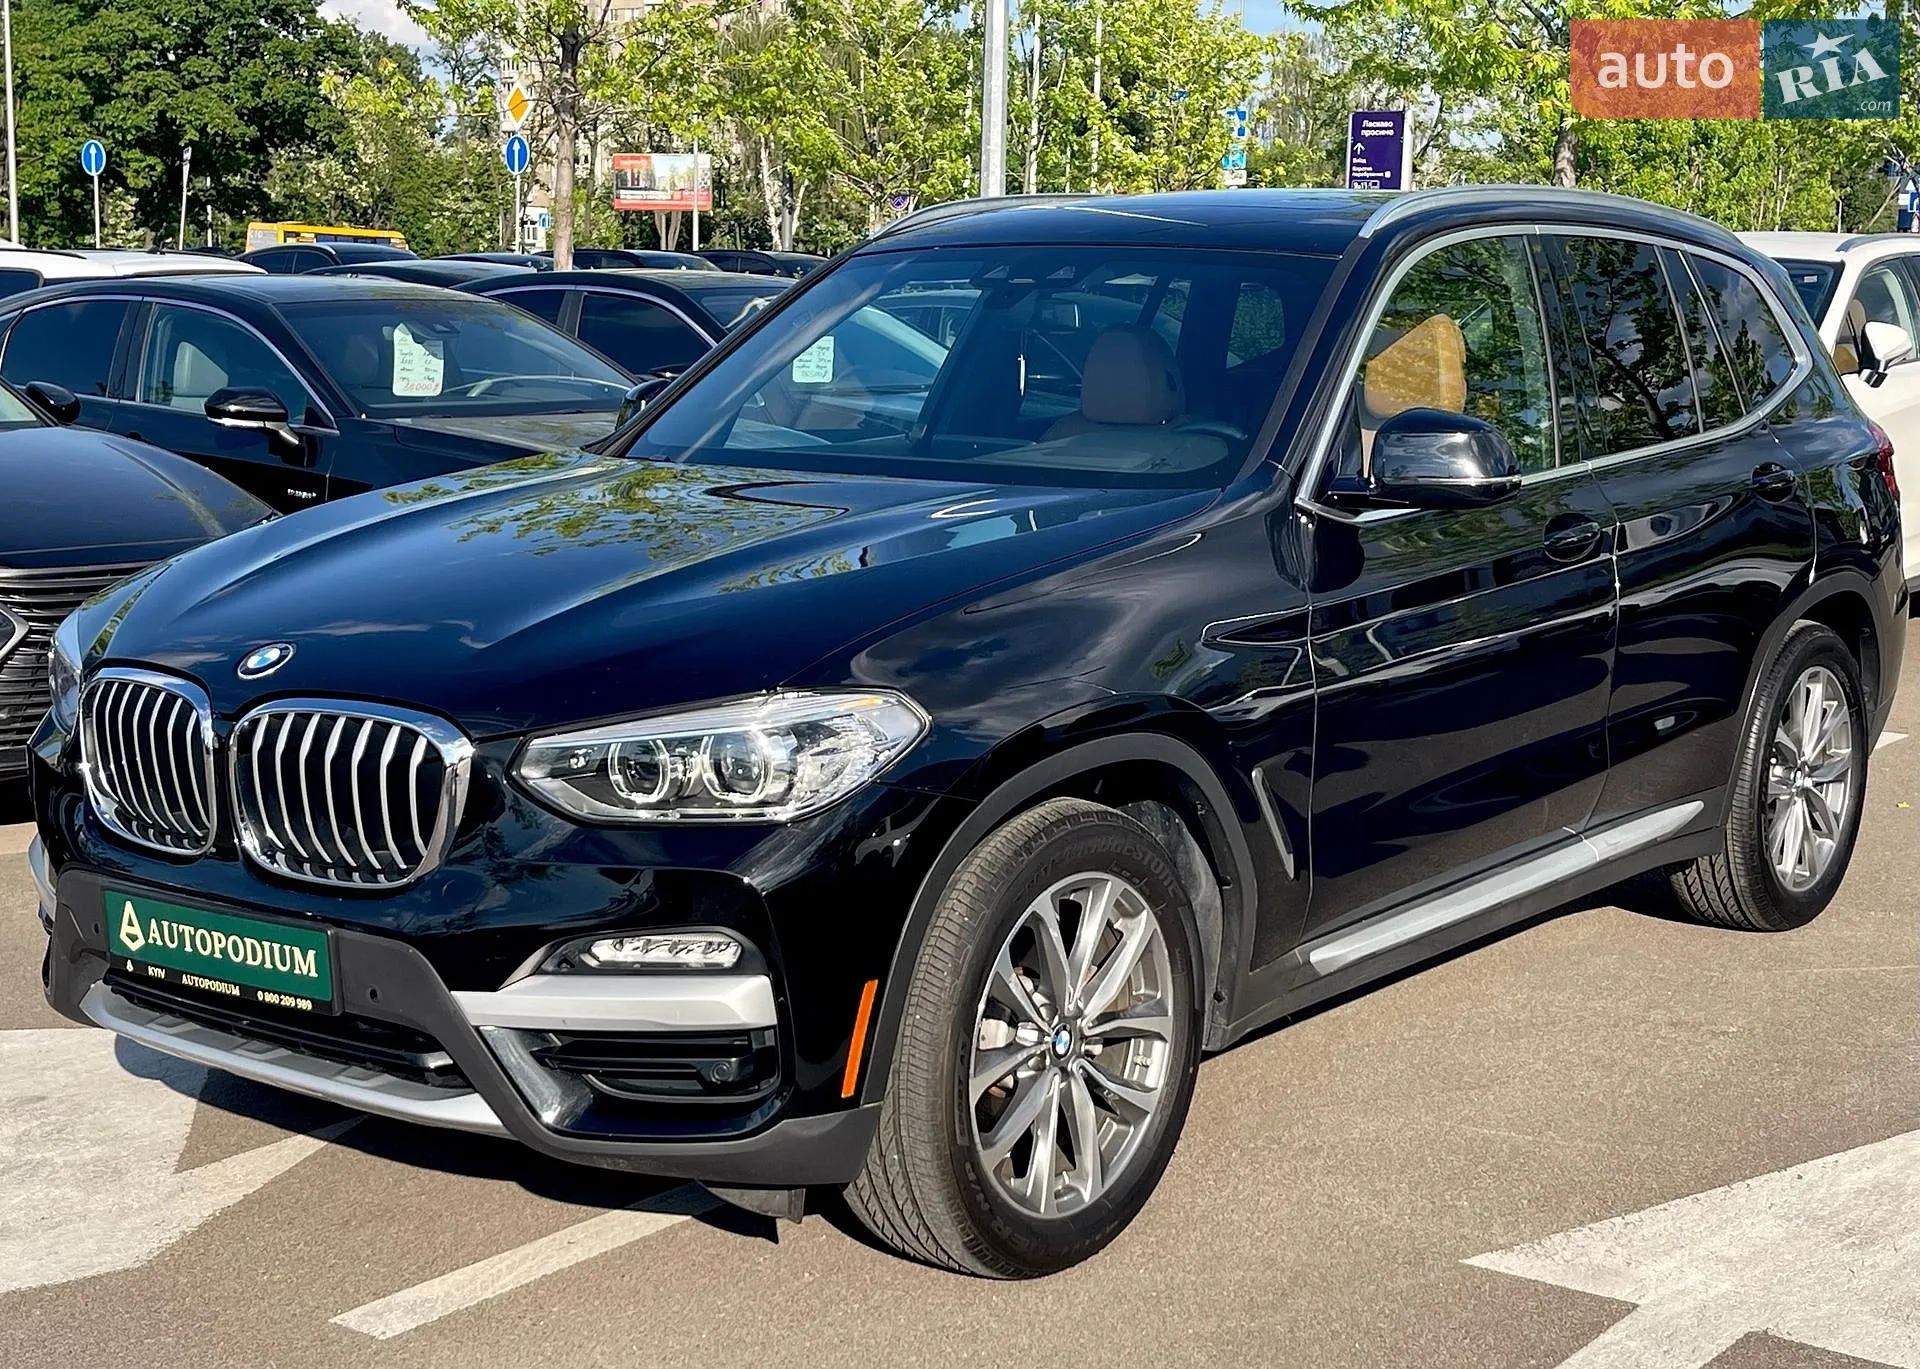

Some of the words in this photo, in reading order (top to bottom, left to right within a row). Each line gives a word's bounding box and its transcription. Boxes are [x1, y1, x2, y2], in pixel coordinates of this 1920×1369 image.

[1361, 129, 1394, 137] просимо
[148, 918, 319, 978] AUTOPODIUM
[147, 965, 166, 979] KYIV
[181, 973, 240, 997] AUTOPODIUM
[257, 990, 264, 1001] 0
[264, 991, 280, 1005] 800
